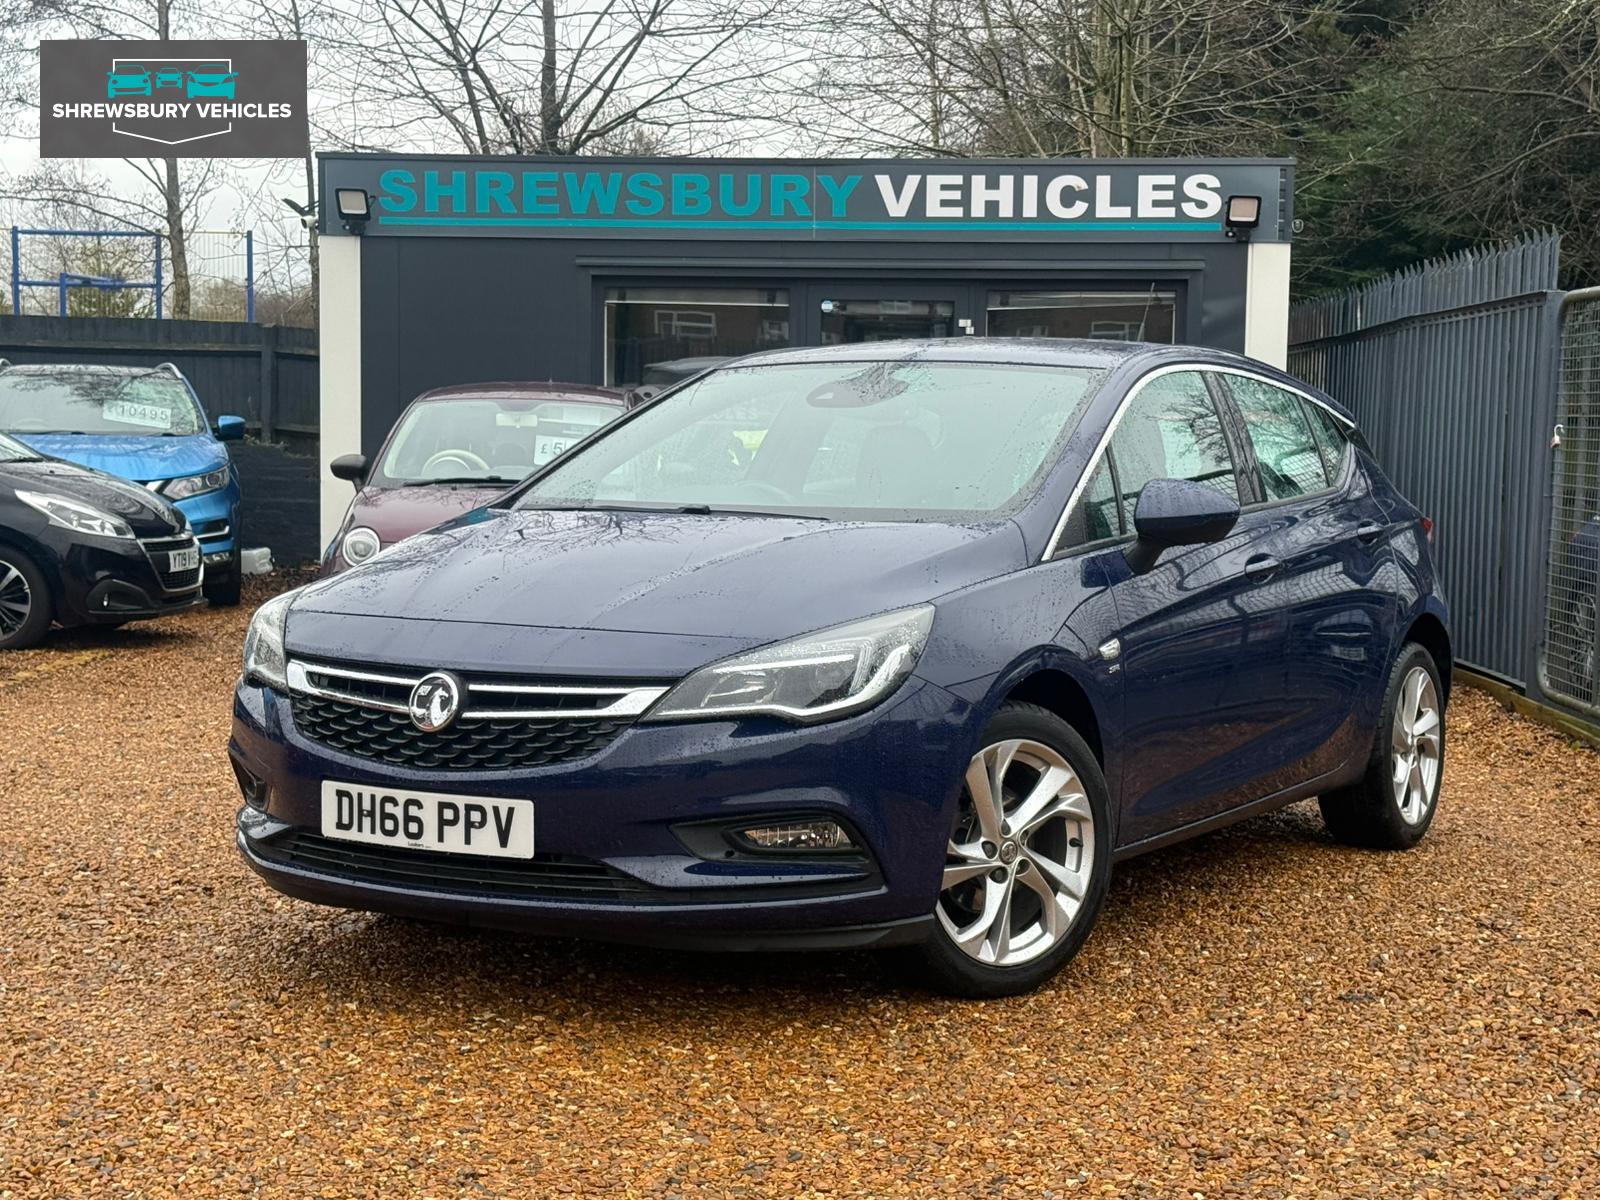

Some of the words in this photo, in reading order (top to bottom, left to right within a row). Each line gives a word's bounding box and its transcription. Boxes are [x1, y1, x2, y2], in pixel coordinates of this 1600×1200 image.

[378, 168, 864, 218] SHREWSBURY
[874, 174, 1223, 219] VEHICLES
[335, 788, 424, 841] DH66
[437, 800, 516, 849] PPV
